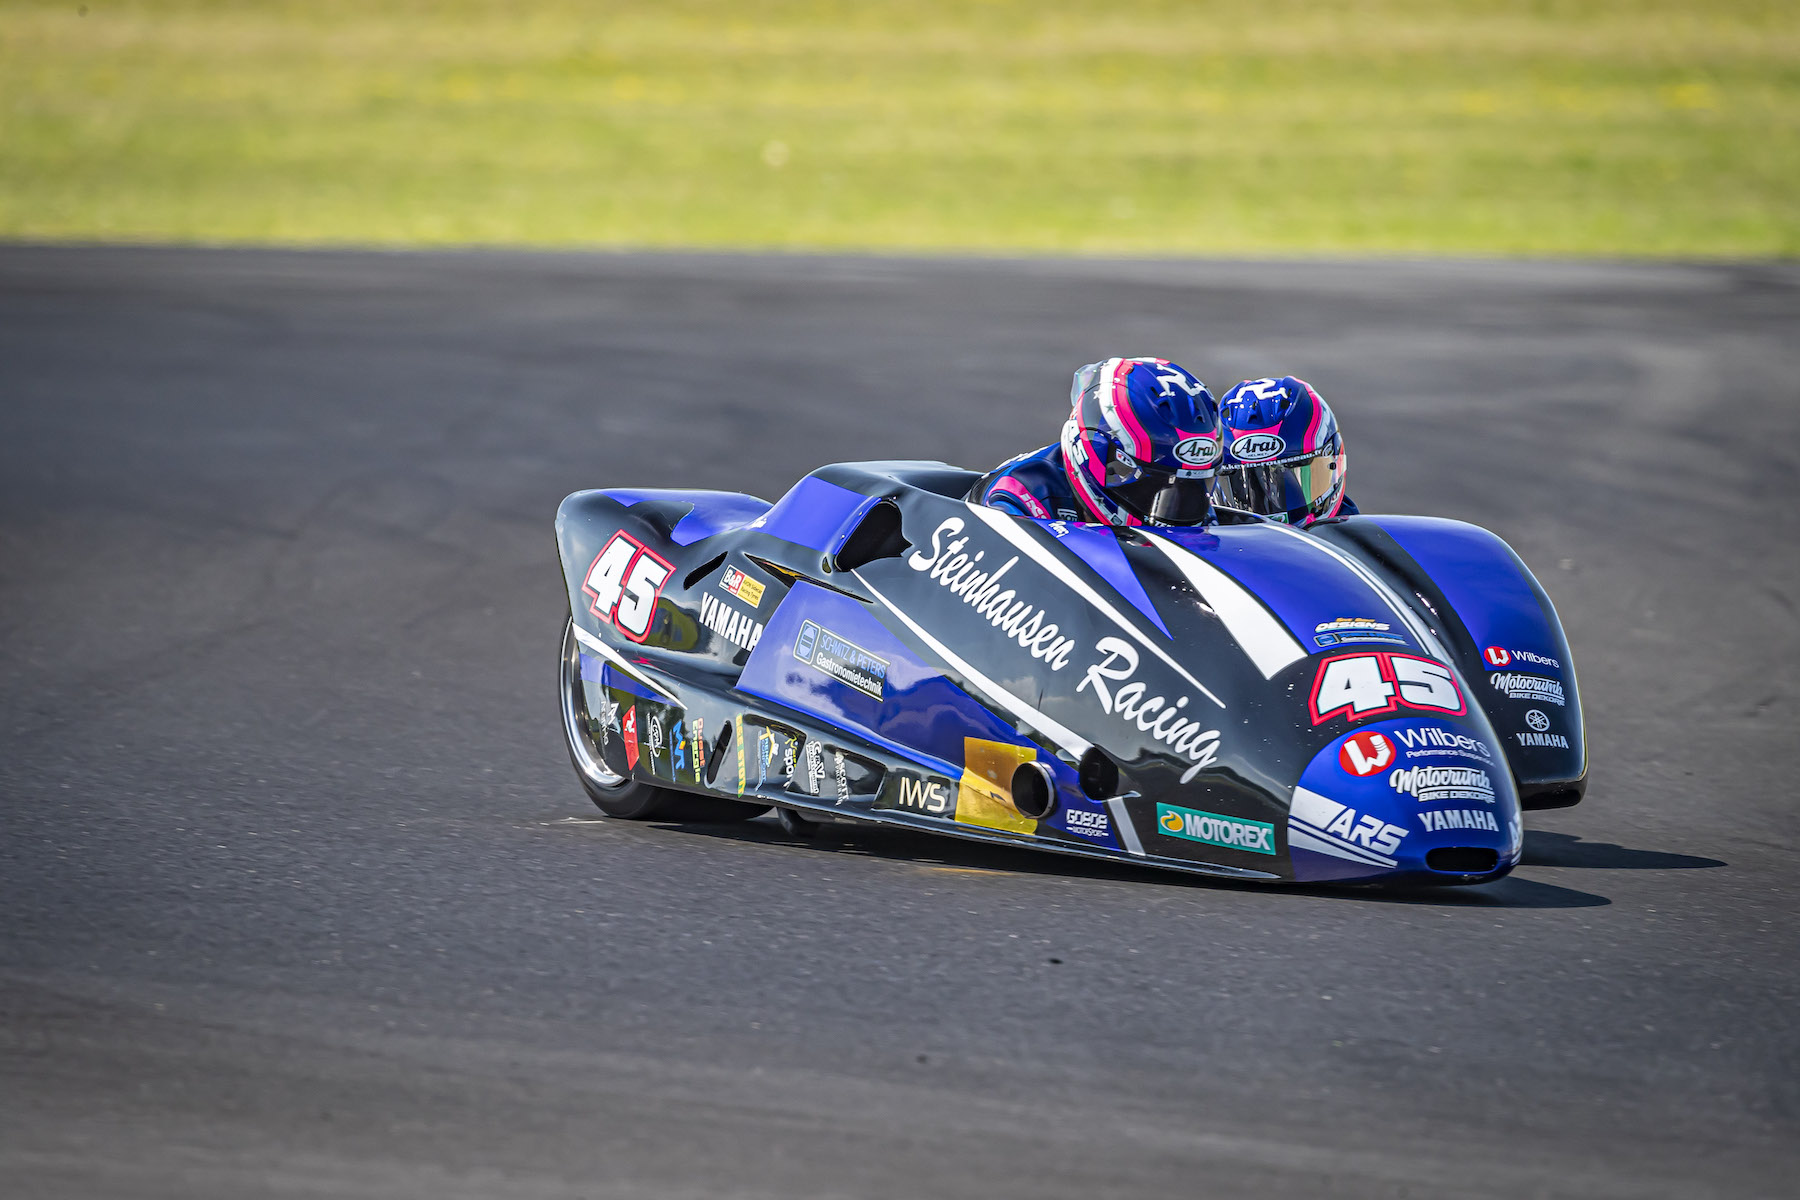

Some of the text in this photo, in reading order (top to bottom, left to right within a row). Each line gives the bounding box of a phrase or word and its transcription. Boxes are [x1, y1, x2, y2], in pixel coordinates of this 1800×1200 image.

[1180, 442, 1214, 457] Arai
[1237, 438, 1278, 454] Arai
[585, 532, 671, 637] 45
[723, 569, 743, 589] B&R
[699, 591, 763, 652] YAMAHA
[820, 634, 886, 679] SCHMITZ & PETERS
[908, 517, 1221, 784] Steinhausen Racing
[1511, 649, 1560, 669] Wilbers
[816, 652, 882, 696] Gastronomietechnik
[1313, 653, 1463, 717] 45
[1394, 727, 1491, 758] Wilbers
[1516, 732, 1570, 749] YAMAHA
[899, 776, 946, 812] IWS
[1418, 790, 1449, 802] BIKE
[1184, 813, 1271, 851] MOTOREX
[1327, 807, 1409, 856] ARS
[1417, 809, 1499, 832] YAMAHA
